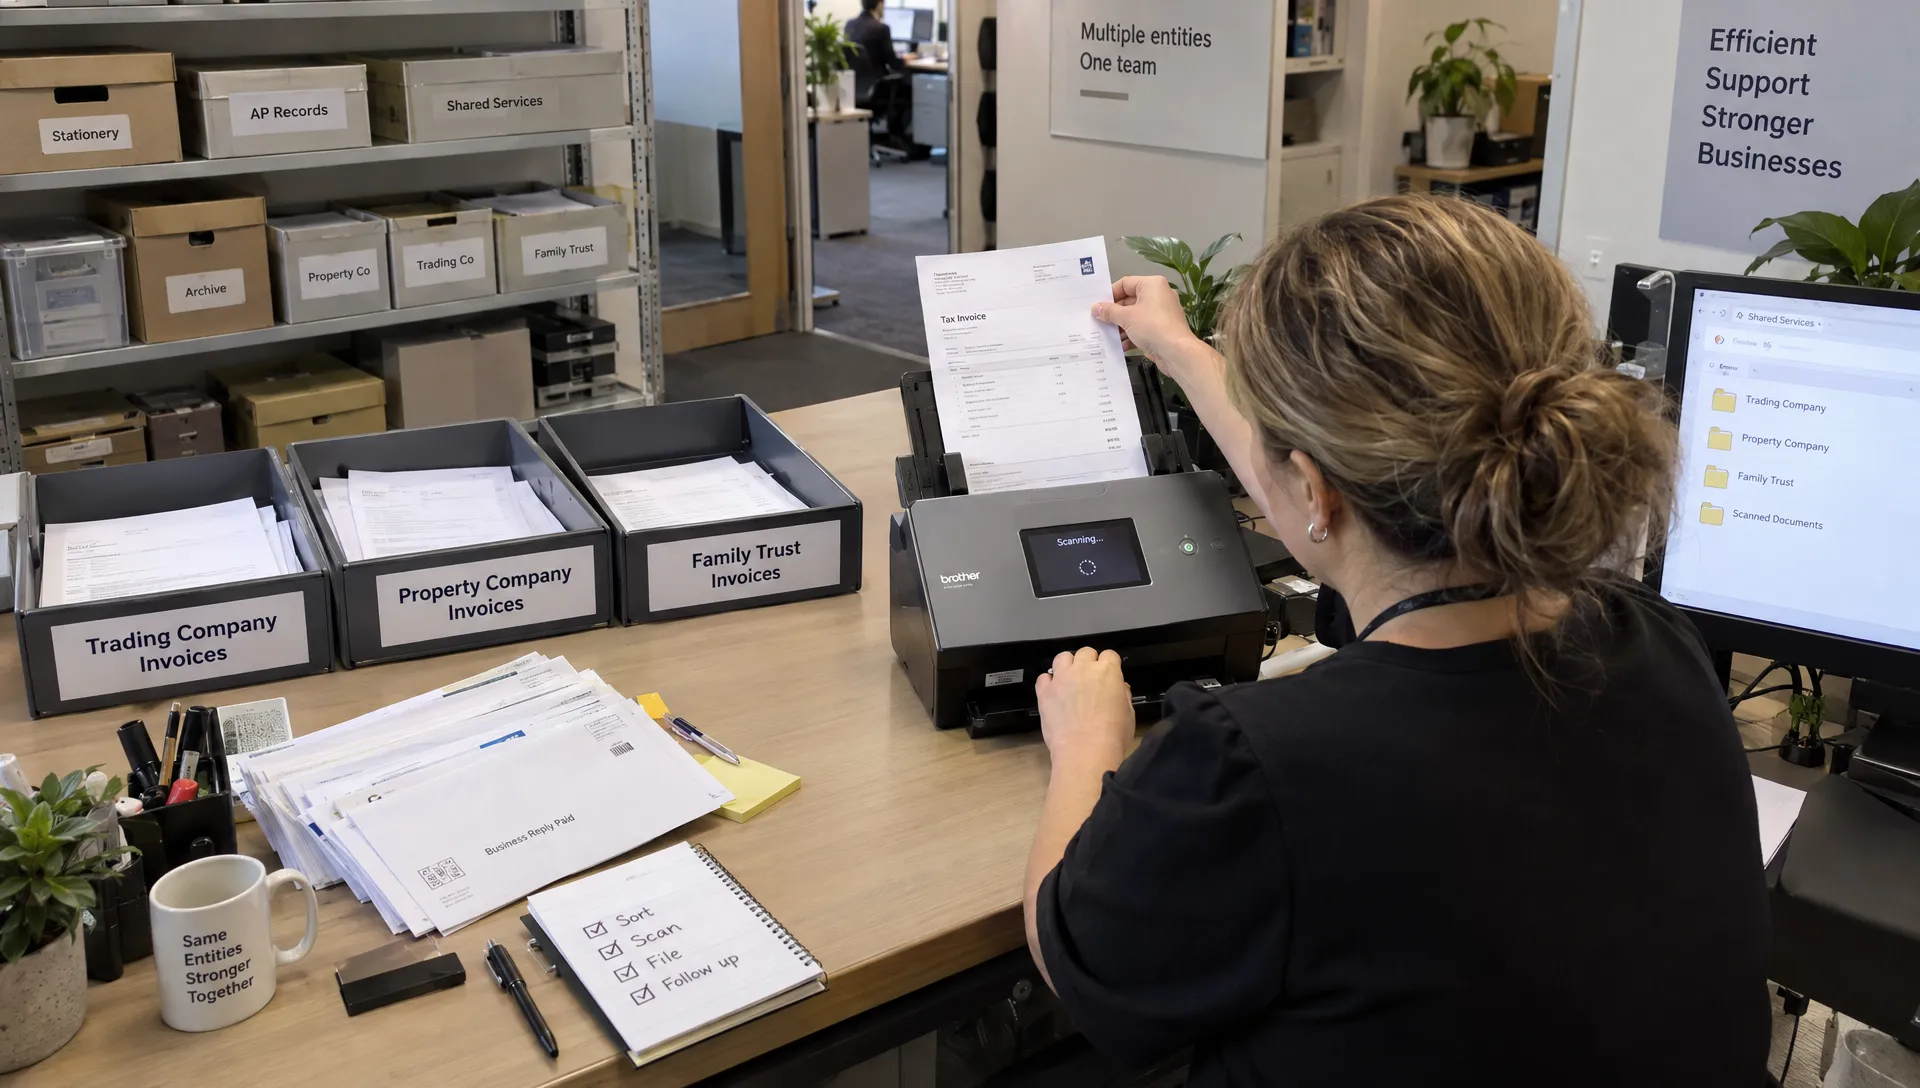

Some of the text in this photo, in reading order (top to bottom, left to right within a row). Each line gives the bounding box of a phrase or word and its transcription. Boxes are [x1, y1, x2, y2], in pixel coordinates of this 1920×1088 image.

[1081, 21, 1212, 48] Multiple entities
[1709, 28, 1818, 57] Efficient
[1080, 51, 1157, 76] One team
[1705, 66, 1811, 99] Support
[250, 103, 329, 120] AP Records
[447, 95, 543, 112] Shared Services
[1701, 104, 1815, 140] Stronger
[52, 128, 119, 142] Stationery
[1697, 141, 1842, 179] Businesses
[534, 243, 594, 259] Family Trust
[416, 254, 475, 271] Trading Co
[308, 266, 371, 283] Property Co
[185, 284, 227, 298] Archive
[940, 312, 987, 324] Tax Invoice
[1747, 312, 1815, 328] Shared Services
[1746, 394, 1827, 415] Trading Company
[1741, 433, 1830, 455] Property Company
[1737, 471, 1795, 488] Family Trust
[1732, 509, 1824, 530] Scanned Documents
[1056, 535, 1104, 547] Scanning...
[692, 540, 802, 571] Family Trust
[398, 567, 572, 604] Property Company
[711, 567, 781, 589] Invoices
[940, 571, 980, 584] brother
[448, 598, 524, 621] Invoices
[85, 615, 278, 655] Trading Company
[138, 644, 228, 673] Invoices
[483, 814, 576, 856] Business Reply Paid
[616, 907, 655, 928] Sort
[183, 931, 227, 948] Same
[631, 923, 684, 947] Scan
[184, 944, 243, 967] Entities
[646, 950, 684, 970] File
[186, 957, 251, 985] Stronger
[661, 954, 740, 992] Follow up
[187, 976, 254, 1004] Together
